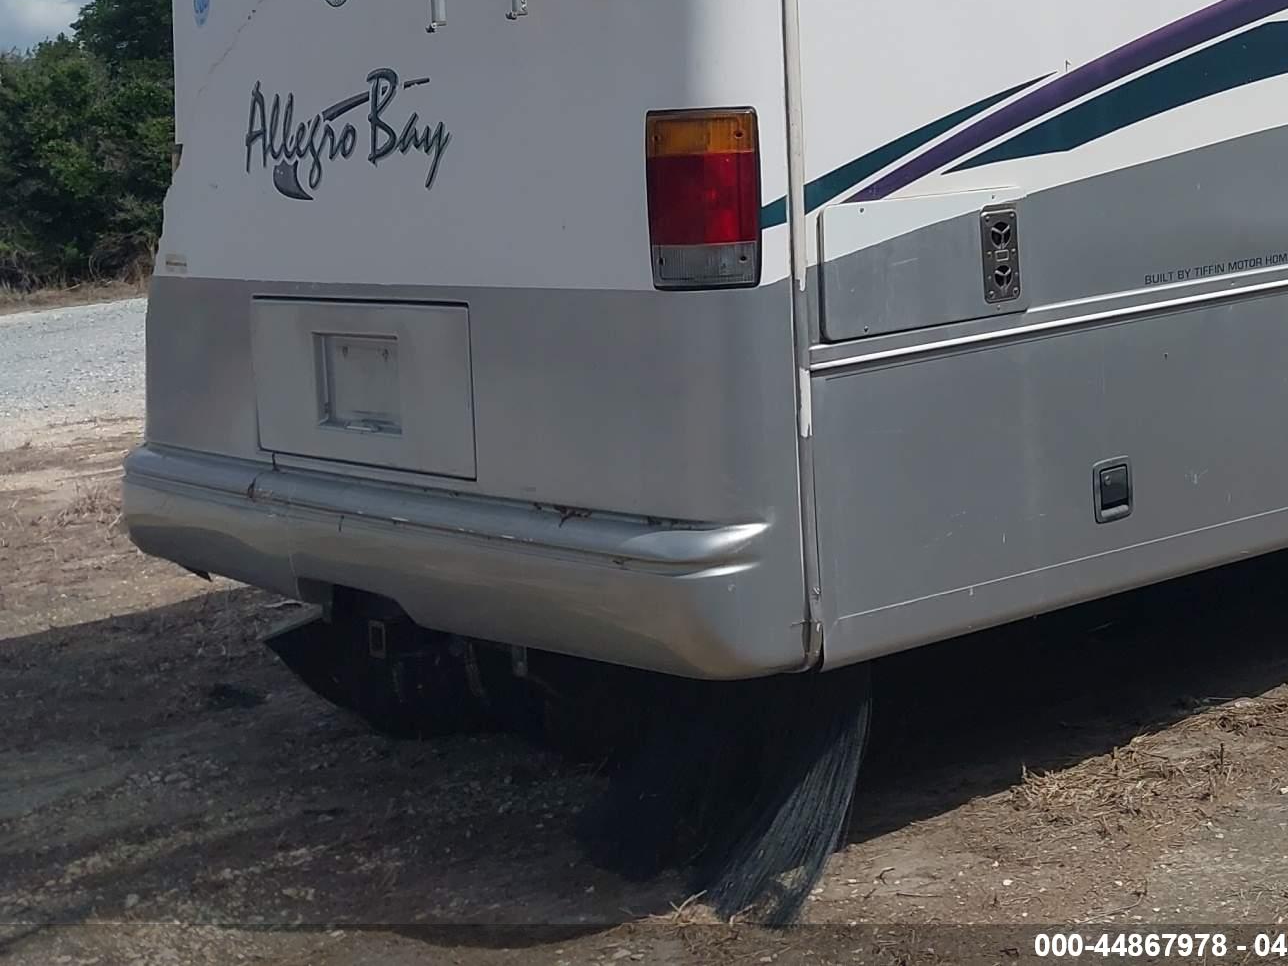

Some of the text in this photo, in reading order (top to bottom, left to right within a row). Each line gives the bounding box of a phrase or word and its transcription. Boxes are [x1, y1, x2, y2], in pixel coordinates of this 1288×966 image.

[245, 68, 452, 190] Allegro Bay
[1144, 271, 1174, 285] BUILT
[1177, 268, 1192, 280] BY
[1194, 263, 1225, 277] TIFFIN
[1228, 256, 1263, 272] MOTOR
